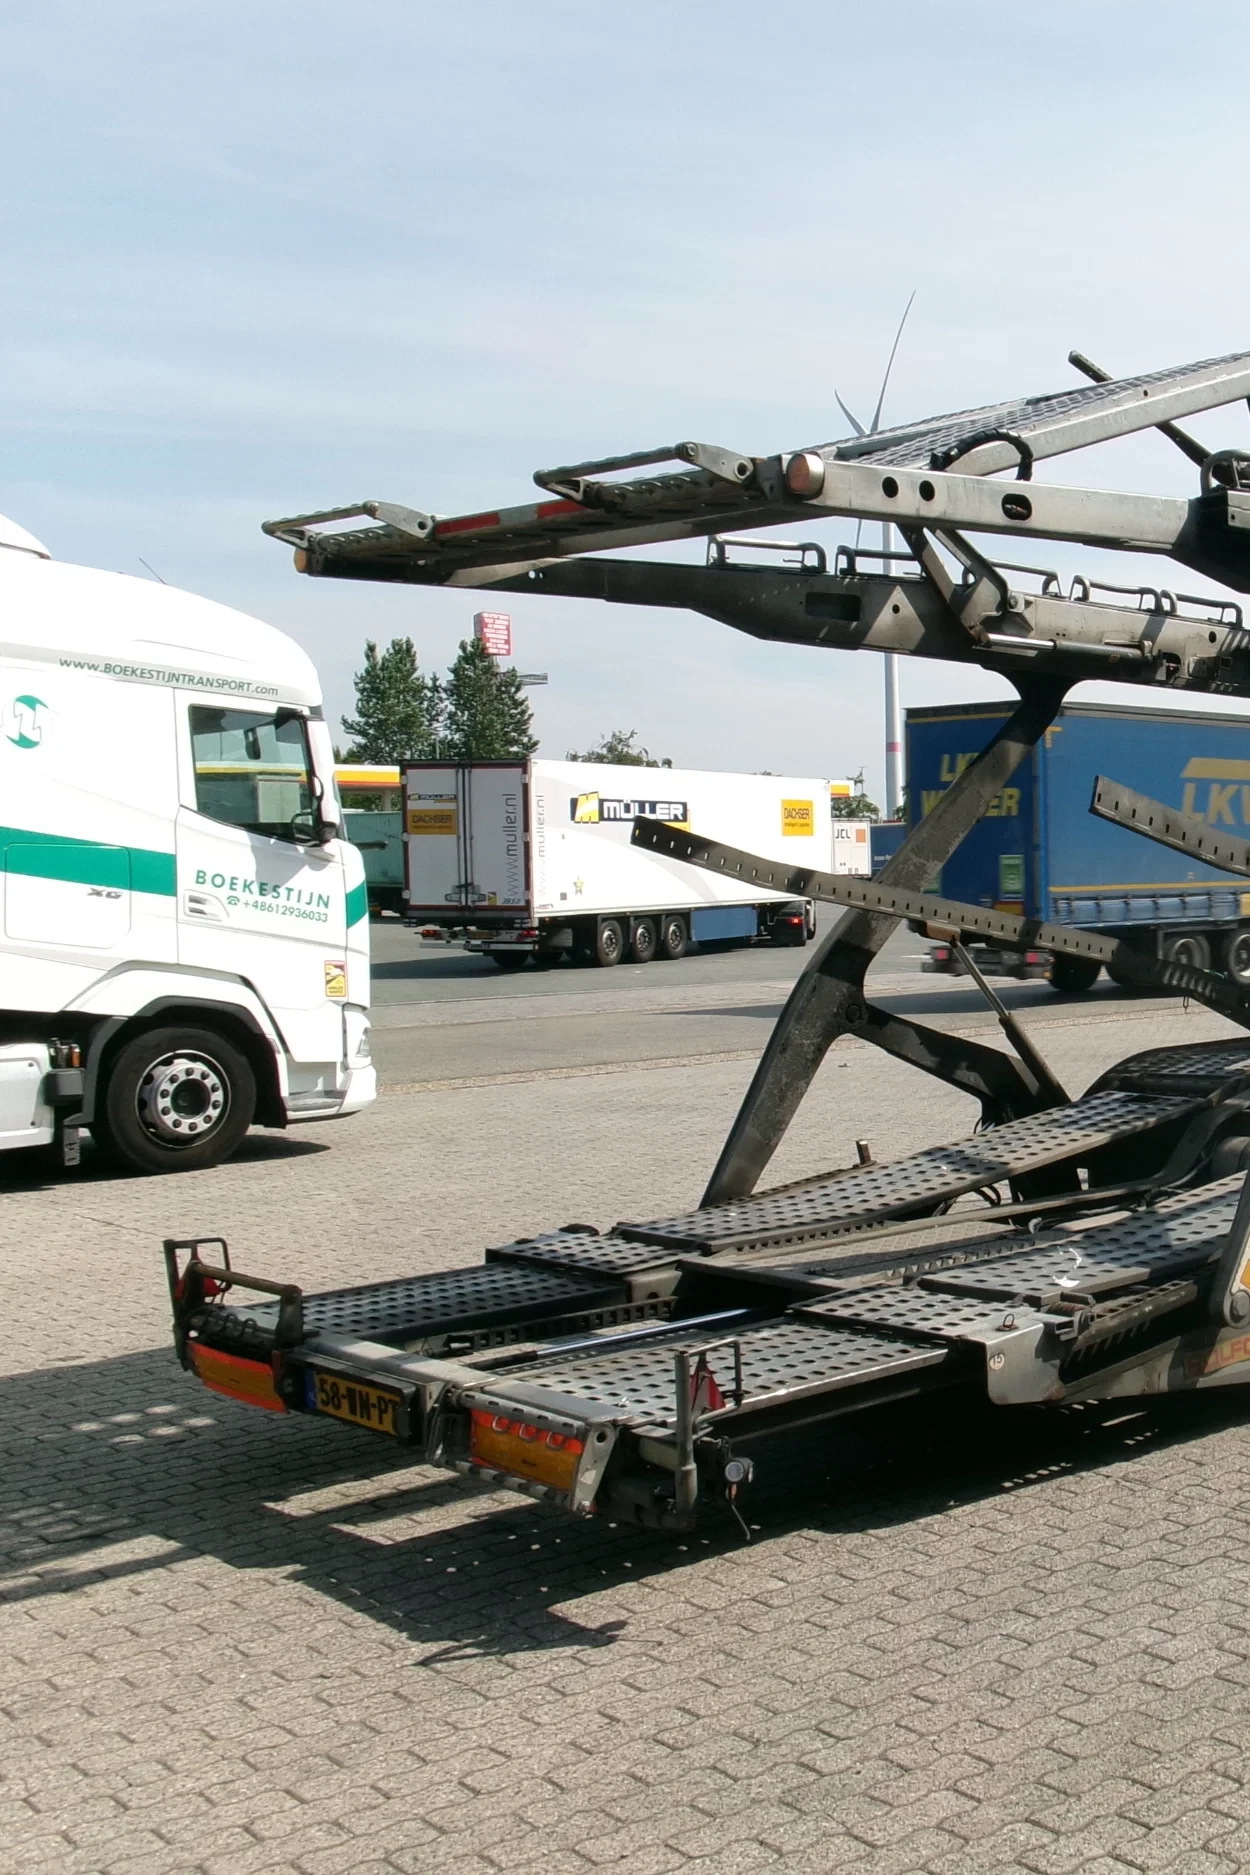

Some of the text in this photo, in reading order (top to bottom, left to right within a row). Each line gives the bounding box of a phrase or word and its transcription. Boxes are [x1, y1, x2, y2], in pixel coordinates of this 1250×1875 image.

[58, 657, 279, 697] www.BOEKESTIJNTRANSPORT.com
[412, 814, 452, 823] DACHSER
[602, 799, 684, 820] MÜLLER
[784, 807, 810, 820] DACHSER
[502, 793, 519, 898] www.muller.nl
[195, 869, 331, 909] BOEKESTIJN
[243, 899, 329, 922] +48612936033
